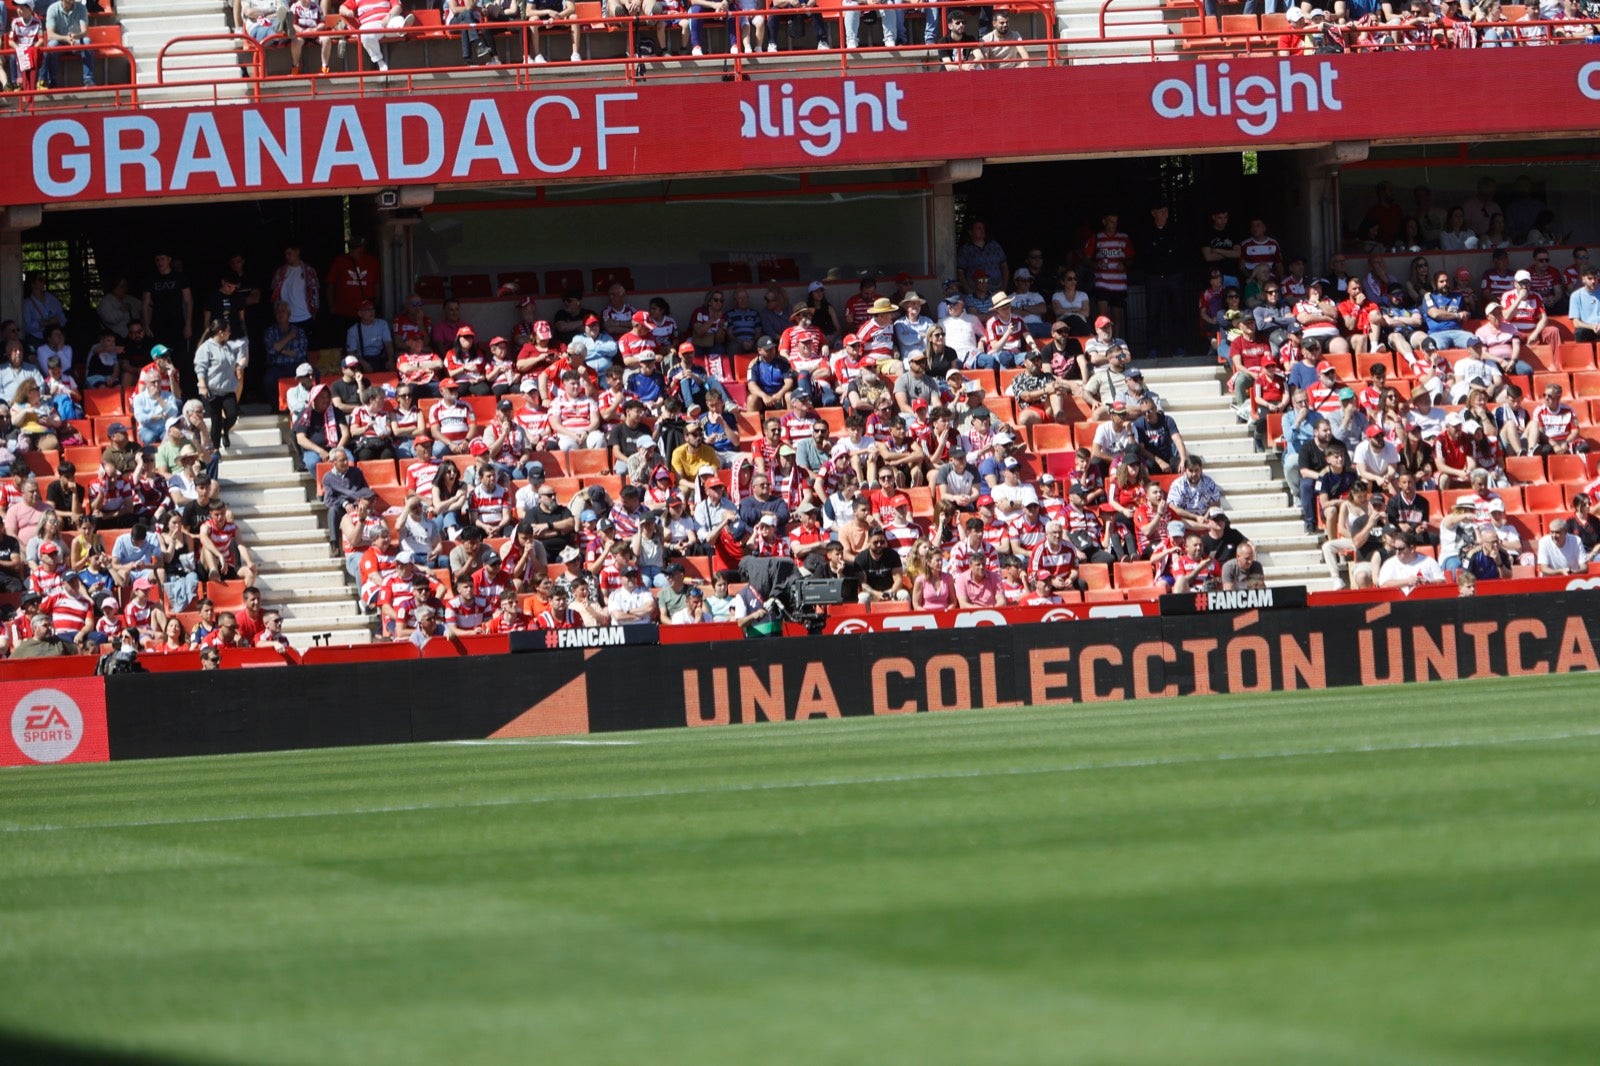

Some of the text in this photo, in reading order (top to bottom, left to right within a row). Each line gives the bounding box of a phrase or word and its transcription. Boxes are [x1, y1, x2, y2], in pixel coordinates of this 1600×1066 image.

[1151, 61, 1342, 136] alight
[1195, 588, 1274, 611] #FANCAM
[545, 625, 626, 649] #FANCAM
[683, 602, 1600, 727] UNA COLECCIÓN ÚNICA
[25, 705, 70, 730] EA
[24, 730, 73, 743] SPORTS
